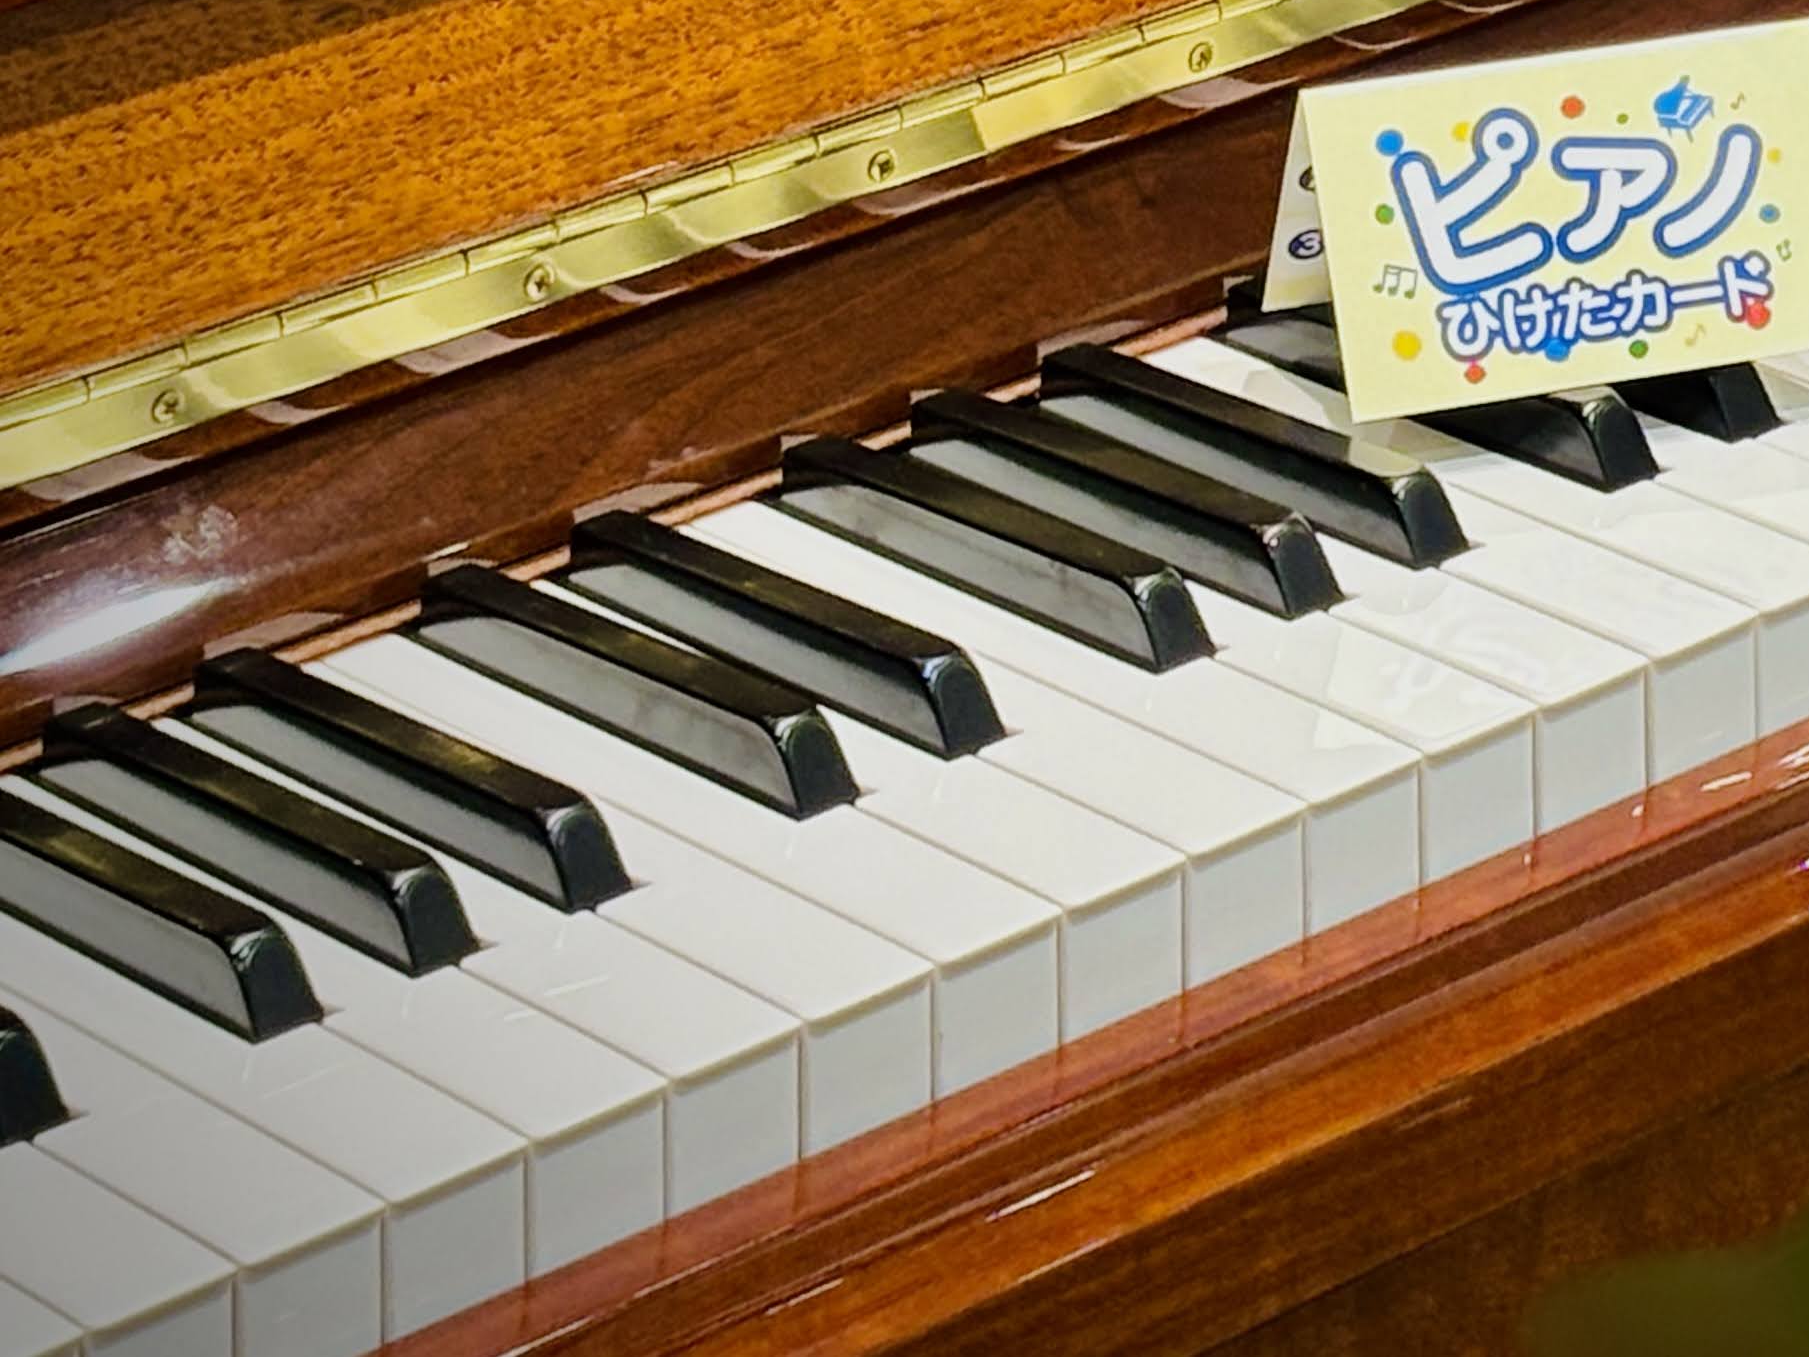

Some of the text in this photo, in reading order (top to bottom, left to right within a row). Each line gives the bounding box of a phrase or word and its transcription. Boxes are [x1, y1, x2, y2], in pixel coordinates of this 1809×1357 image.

[1392, 107, 1764, 294] ピアノ
[1436, 250, 1773, 361] ひけたカード
